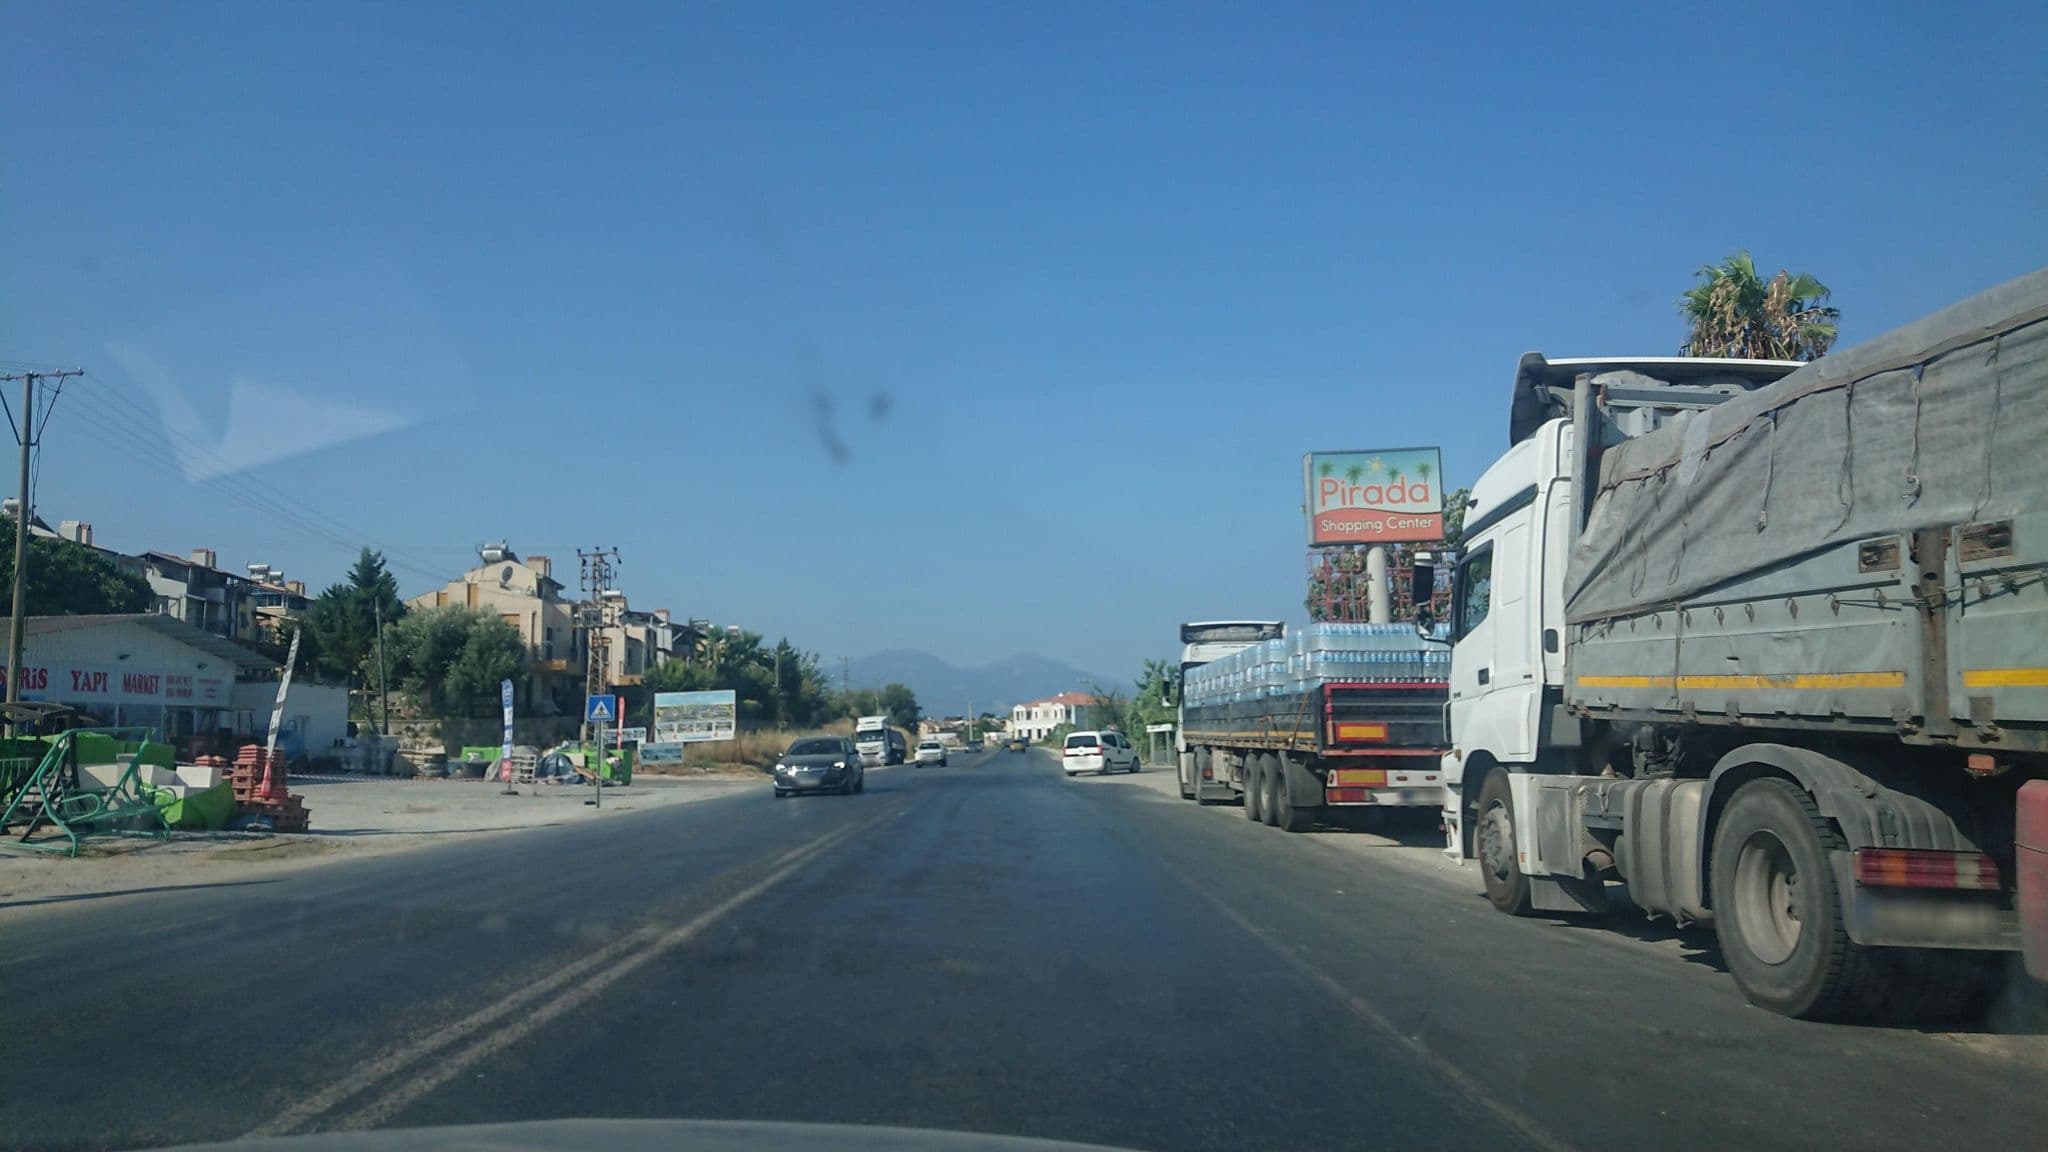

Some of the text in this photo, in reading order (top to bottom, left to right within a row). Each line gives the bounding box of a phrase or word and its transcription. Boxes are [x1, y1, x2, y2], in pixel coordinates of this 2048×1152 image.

[1319, 475, 1430, 508] Pirada
[1321, 516, 1433, 534] Shopping Center
[71, 670, 107, 692] YAPI
[123, 673, 160, 695] MARKET
